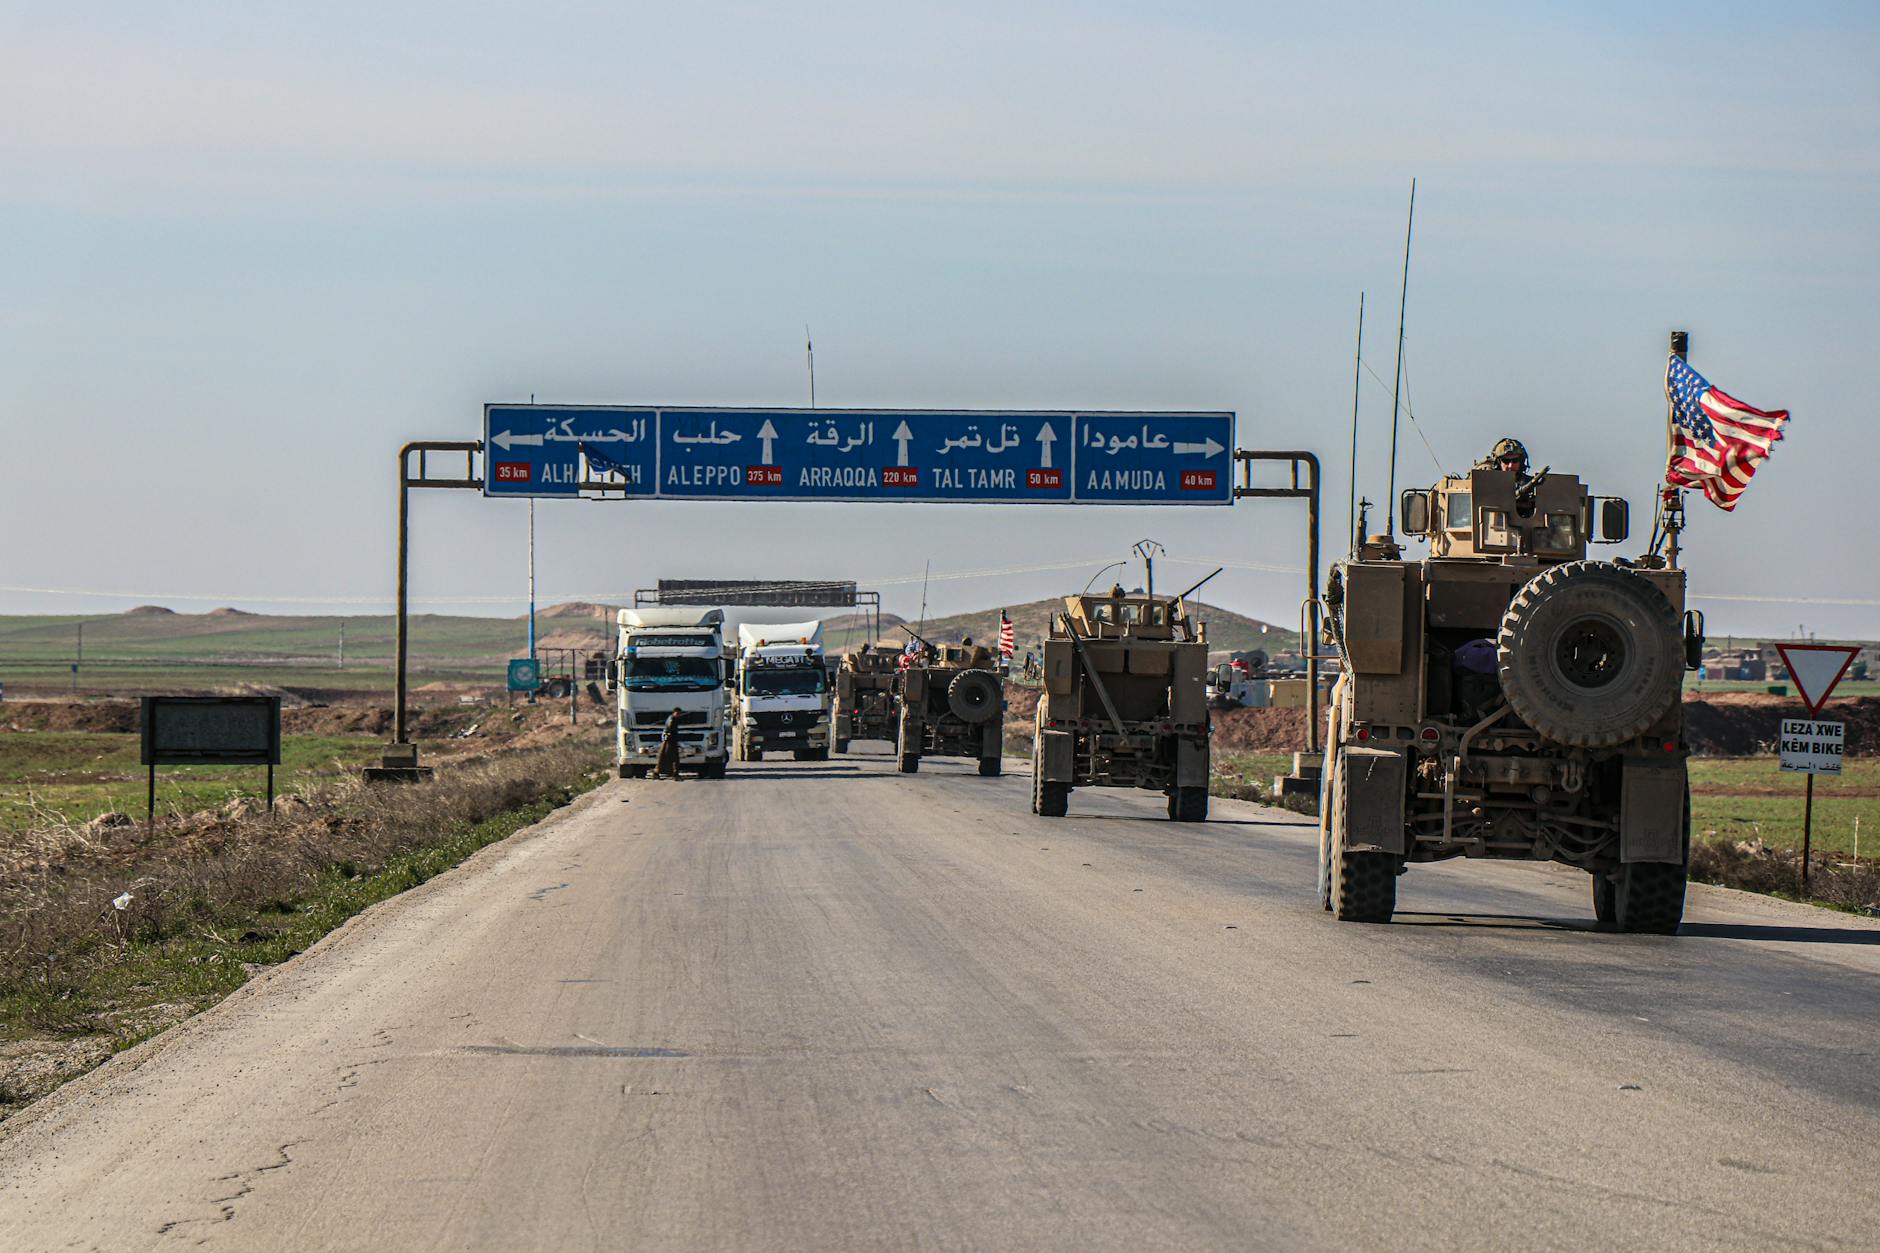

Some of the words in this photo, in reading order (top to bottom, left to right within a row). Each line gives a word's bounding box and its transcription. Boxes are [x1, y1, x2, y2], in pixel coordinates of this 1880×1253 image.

[544, 417, 646, 443] الحسكة
[672, 420, 742, 453] حلب
[806, 419, 874, 453] الرقة
[935, 425, 982, 454] تمر
[986, 423, 1021, 453] تل
[1083, 423, 1170, 455] عامودا
[499, 467, 511, 478] 35
[513, 468, 528, 478] km
[667, 465, 740, 486] ALEPPO
[747, 471, 764, 482] 375
[767, 471, 782, 482] km
[799, 466, 877, 488] ARRAQQA
[883, 472, 900, 483] 220
[902, 472, 917, 483] km
[933, 468, 963, 489] TAL
[968, 468, 1016, 489] TAMR
[1030, 473, 1041, 484] 50
[1044, 473, 1059, 484] km
[1088, 470, 1166, 490] AAMUDA
[1184, 475, 1196, 486] 40
[1197, 475, 1212, 486] km
[1784, 722, 1813, 735] LEZA
[1816, 724, 1842, 736] XWE
[1782, 738, 1809, 753] KÊM
[1812, 742, 1842, 755] BIKE
